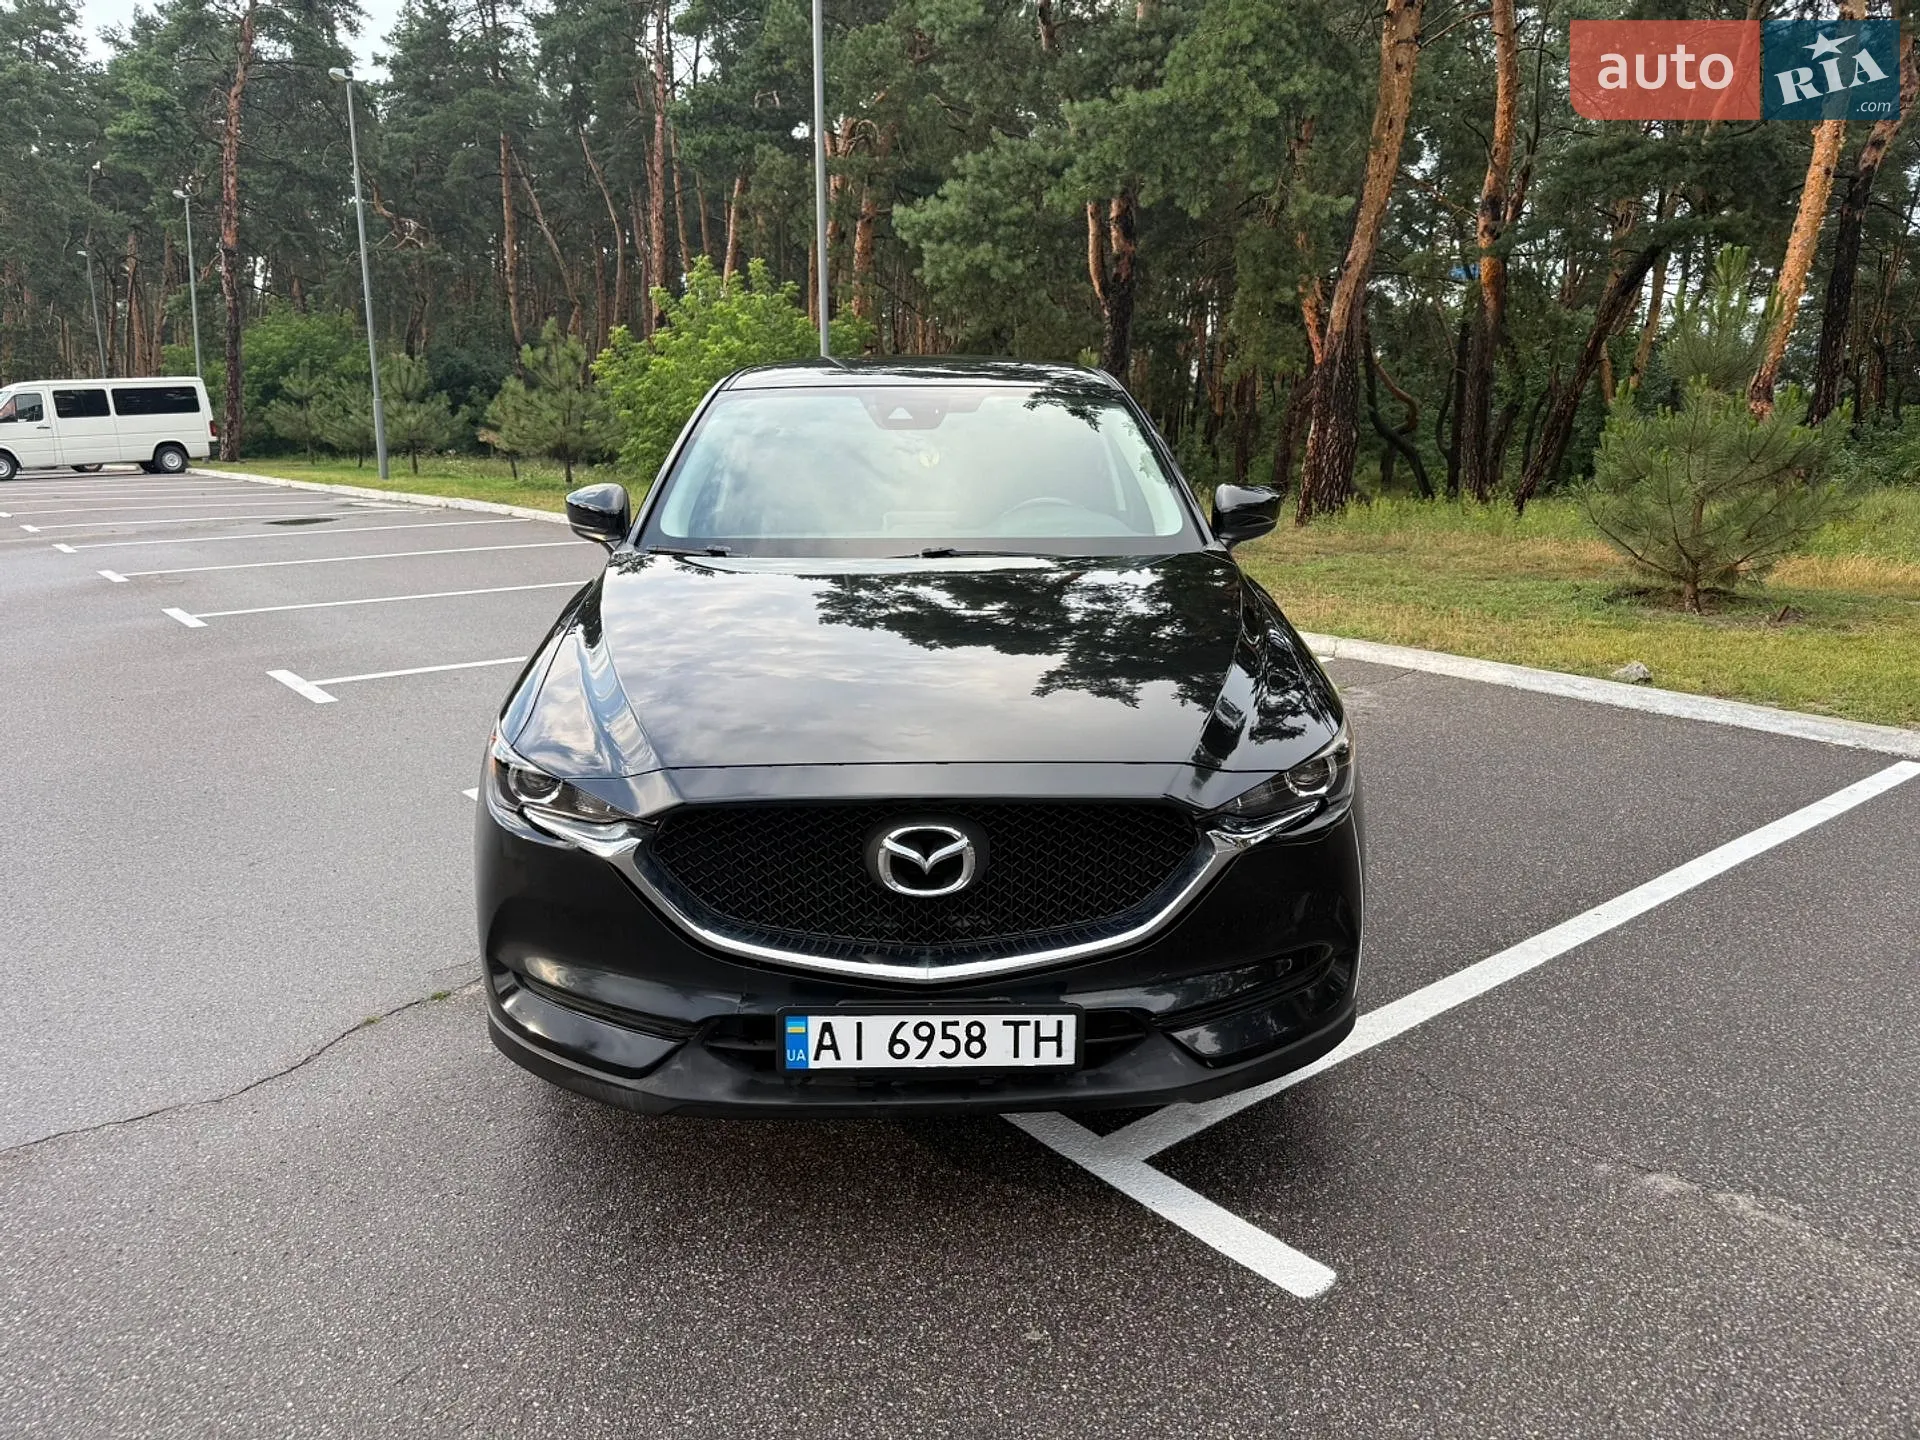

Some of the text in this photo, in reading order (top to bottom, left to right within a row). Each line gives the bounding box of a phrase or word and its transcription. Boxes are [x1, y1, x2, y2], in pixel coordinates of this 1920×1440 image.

[813, 1020, 1063, 1061] AI 6958 TH
[787, 1049, 806, 1062] UA
